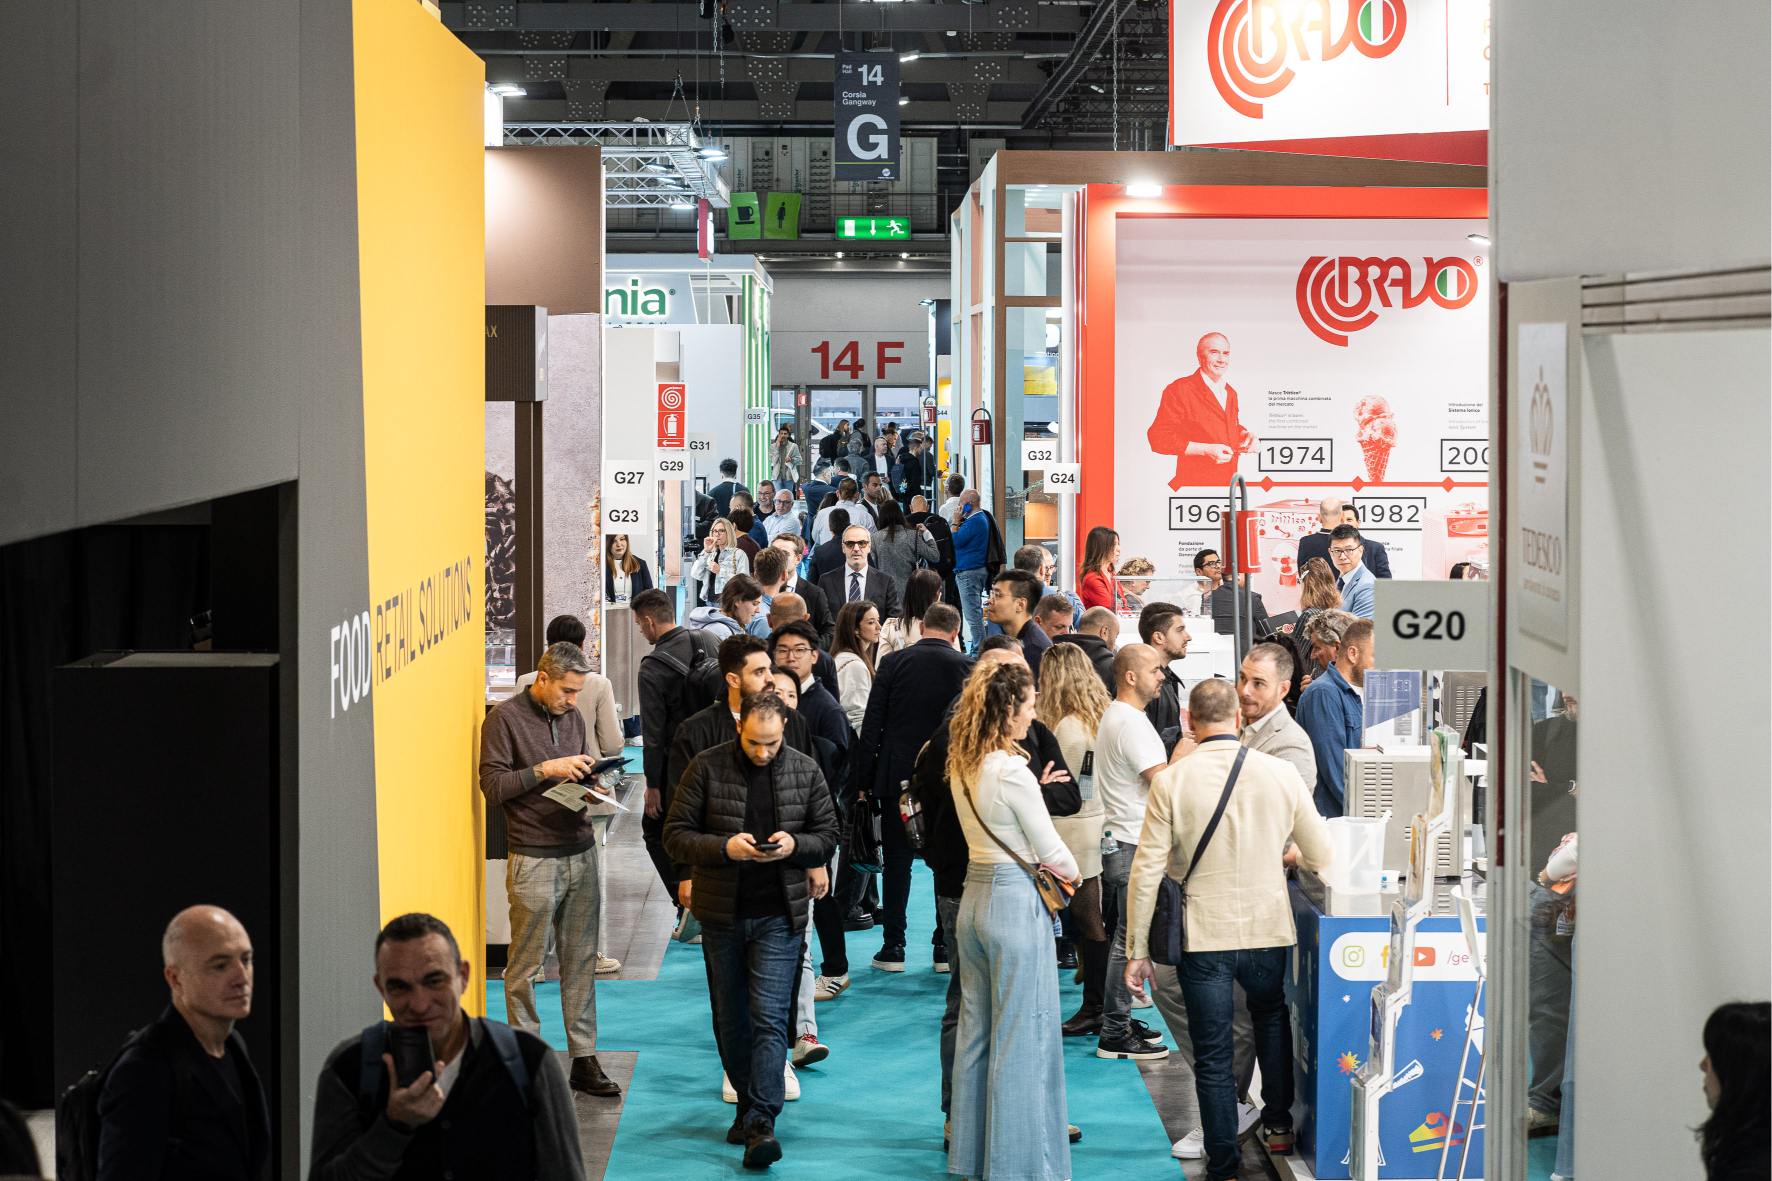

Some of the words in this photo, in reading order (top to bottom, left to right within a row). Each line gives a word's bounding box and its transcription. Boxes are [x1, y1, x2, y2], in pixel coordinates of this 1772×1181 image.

[858, 64, 884, 86] 14
[847, 113, 889, 160] G
[811, 341, 864, 379] 14
[877, 342, 904, 379] F
[689, 441, 710, 450] G31
[1027, 450, 1052, 461] G32
[1267, 447, 1325, 465] 1974
[659, 461, 684, 471] G29
[614, 471, 645, 484] G27
[1050, 473, 1075, 484] G24
[608, 509, 639, 523] G23
[1358, 504, 1420, 523] 1982
[376, 587, 416, 687] RETAIL
[419, 555, 472, 655] SOLUTIONS
[1392, 609, 1466, 641] G20
[331, 611, 371, 719] FOOD
